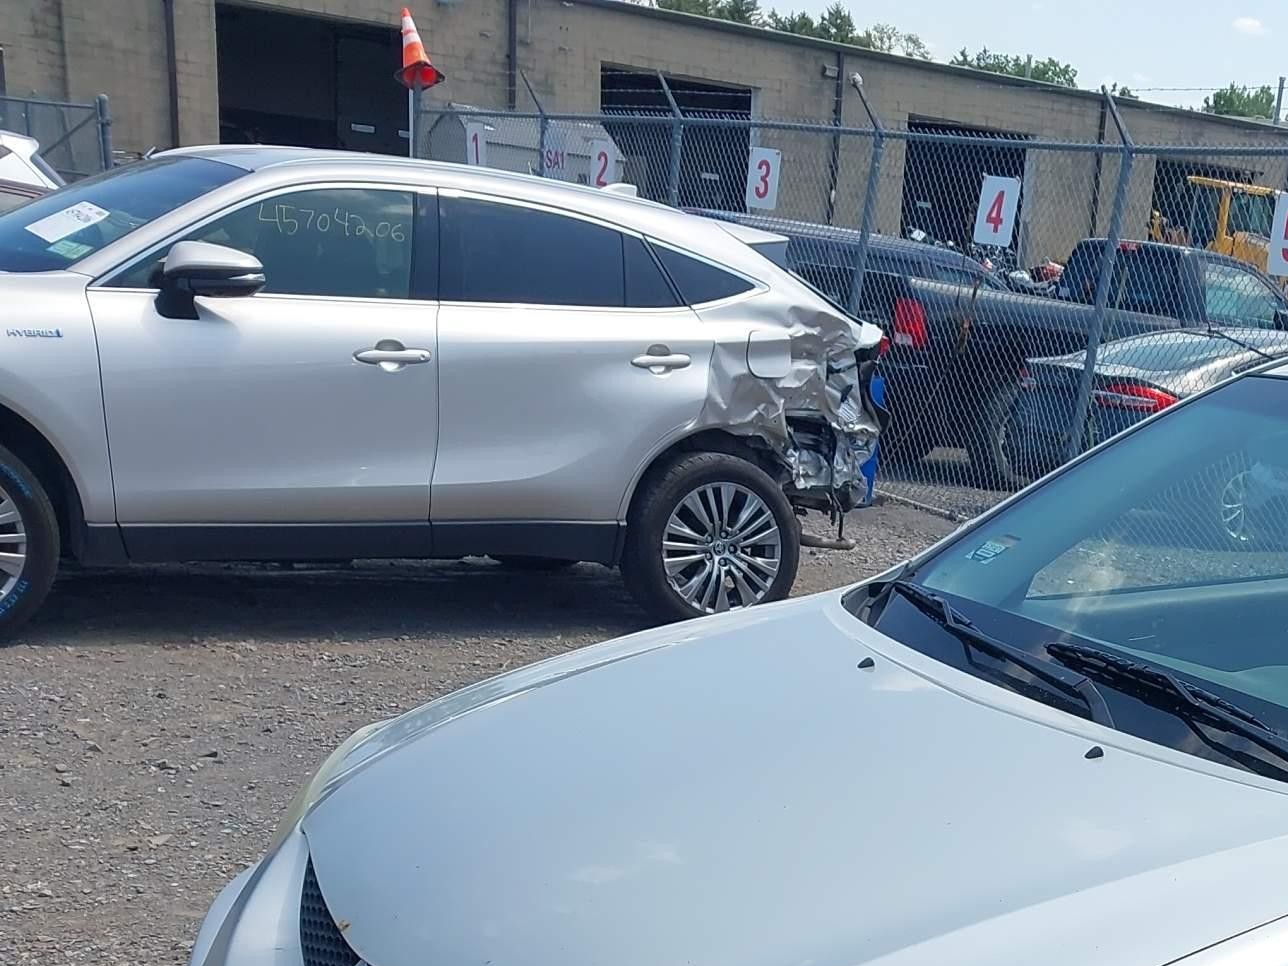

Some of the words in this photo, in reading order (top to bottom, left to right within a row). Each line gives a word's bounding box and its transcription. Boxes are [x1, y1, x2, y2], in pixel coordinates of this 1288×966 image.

[472, 132, 480, 165] 1
[596, 151, 608, 187] 2
[754, 159, 771, 199] 3
[258, 202, 405, 243] 45704206
[985, 190, 1005, 234] 4
